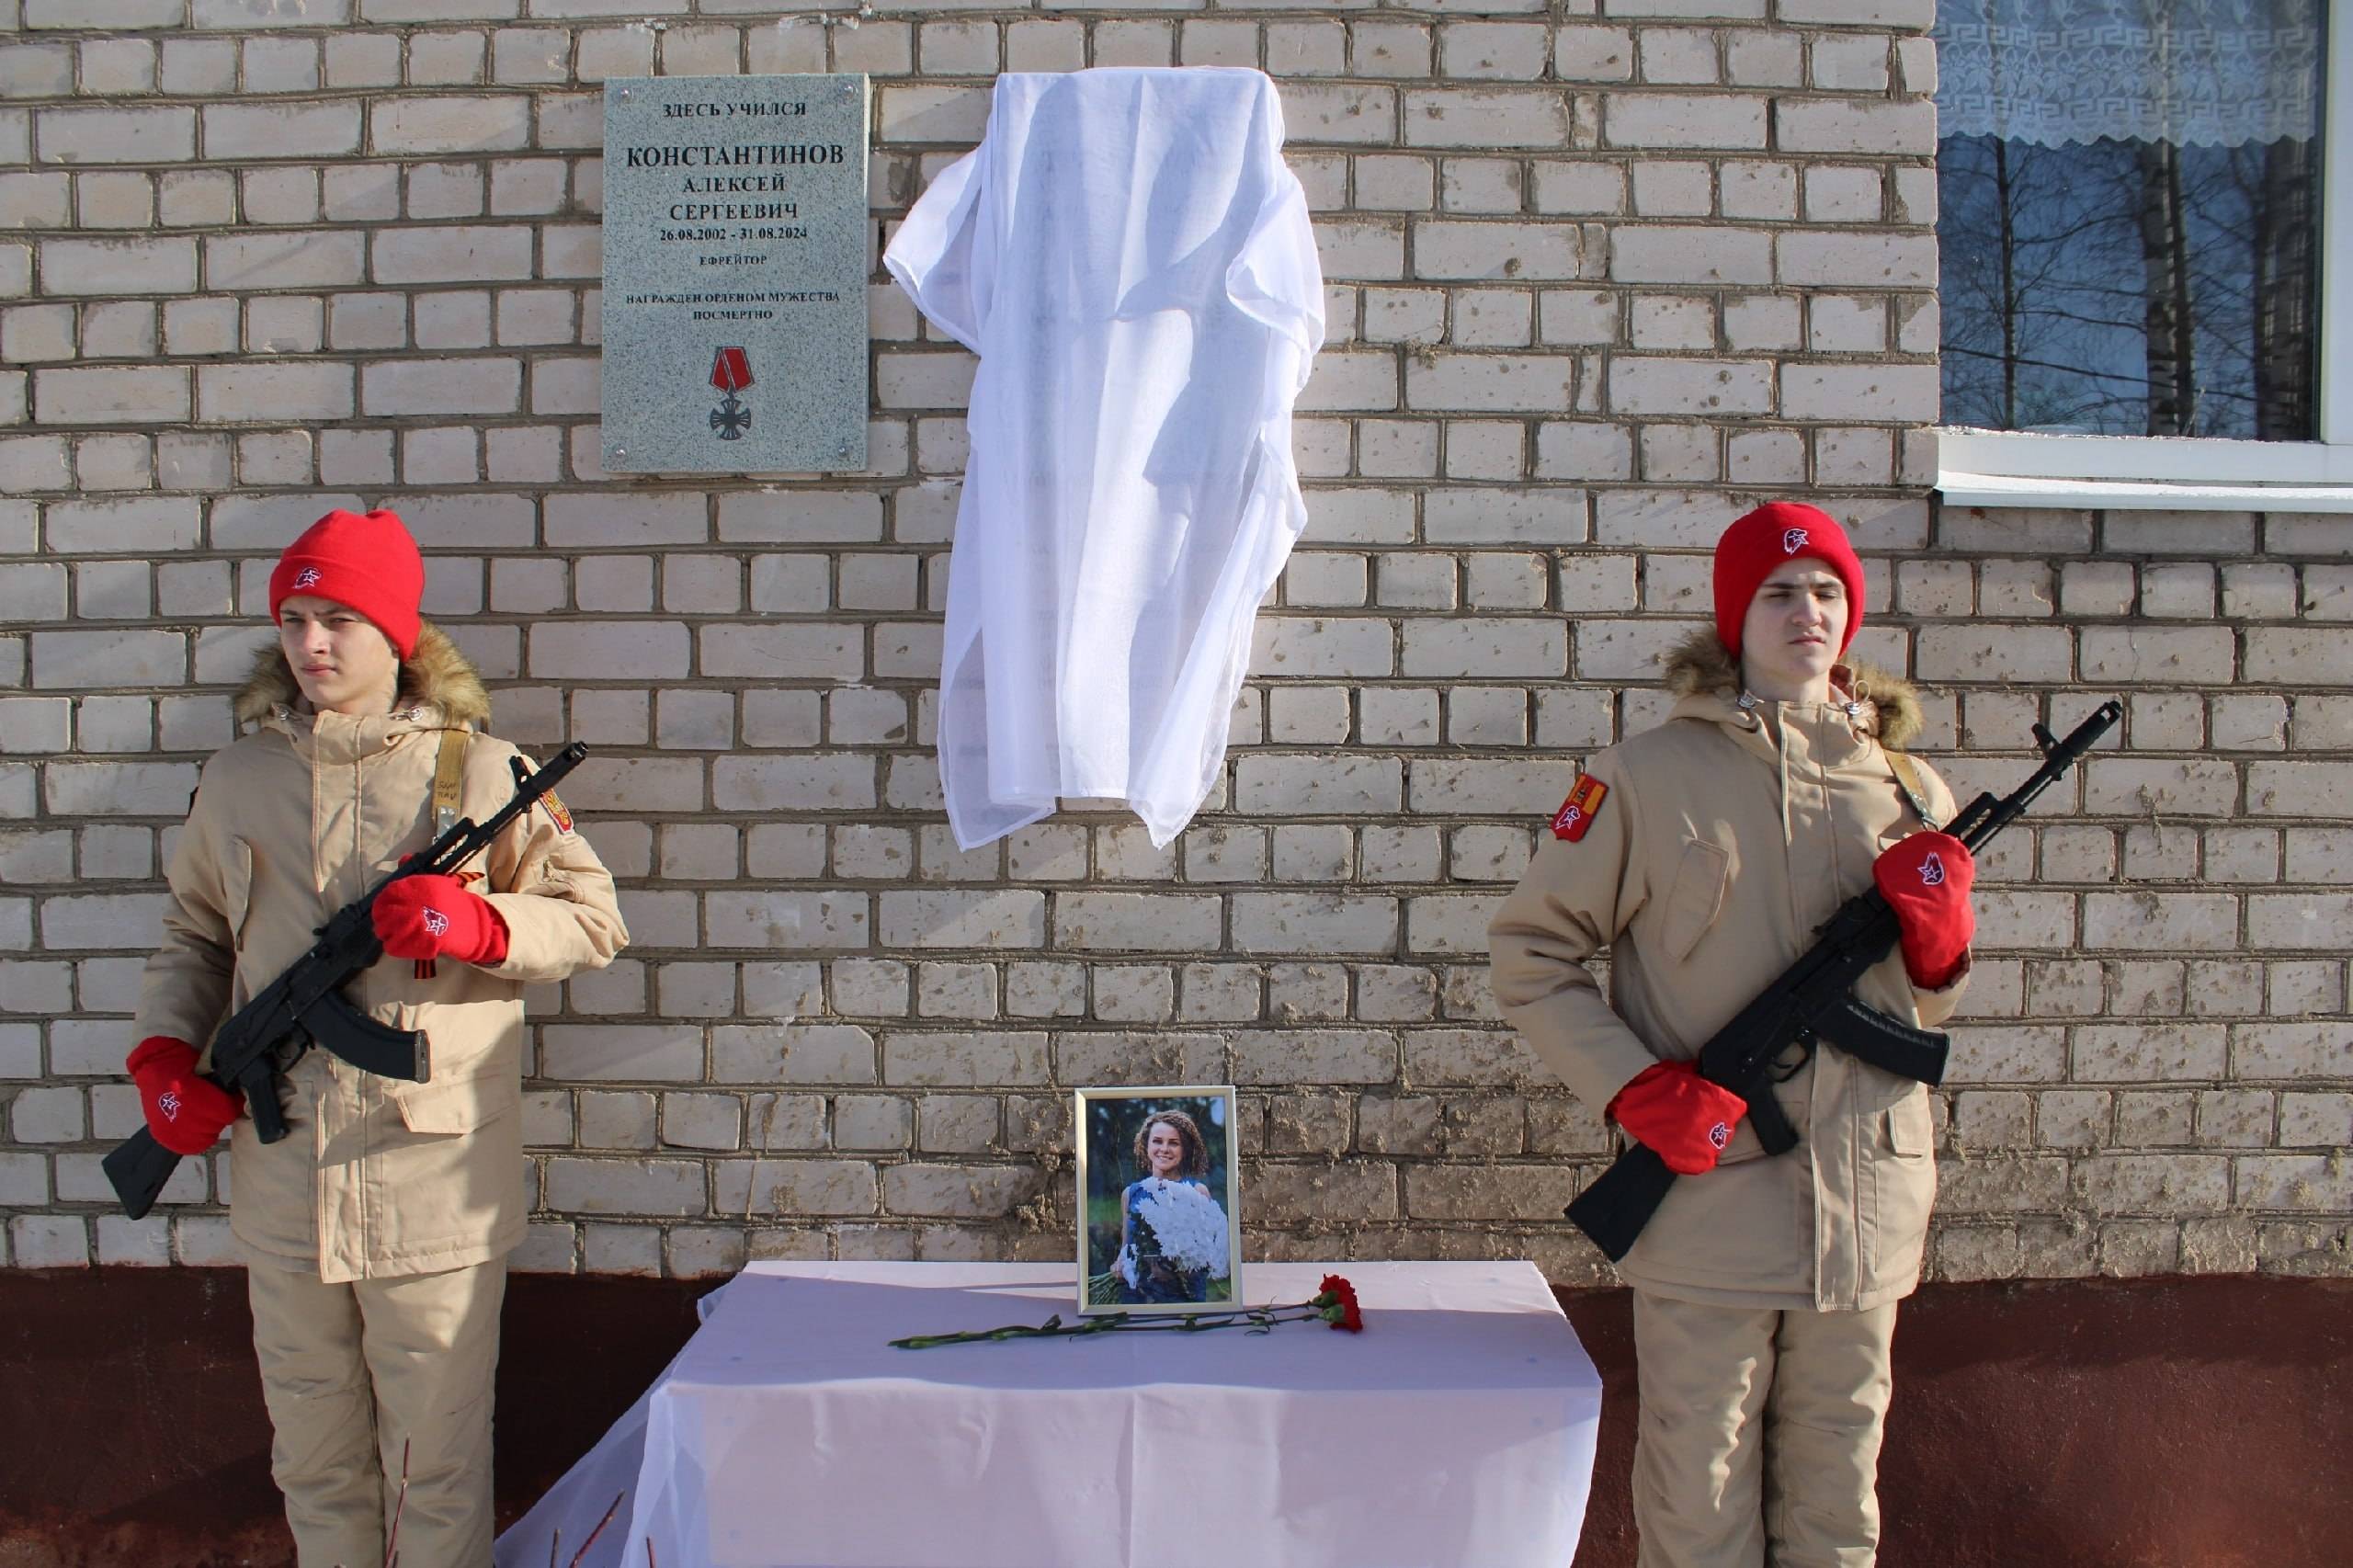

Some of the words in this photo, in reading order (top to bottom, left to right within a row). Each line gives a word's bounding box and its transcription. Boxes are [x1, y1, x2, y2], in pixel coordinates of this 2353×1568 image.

[662, 103, 721, 119] ЗДЕСЬ
[726, 102, 806, 117] УЧИЛСЯ
[626, 144, 845, 167] КОНСТАНТИНОВ
[682, 173, 786, 193] АЛЕКСЕЙ
[669, 203, 799, 221] СЕРГЕЕВИЧ
[659, 228, 727, 242] 26.08.2002
[739, 227, 808, 241] 31.08.2024
[699, 255, 768, 267] ЕФРЕЙТОР
[626, 293, 702, 304] НАГРАЖДЕН
[704, 292, 766, 303] ОРДЕНОМ
[768, 291, 840, 302] МУЖЕСТВА
[692, 310, 774, 321] ПОСМЕРТНО
